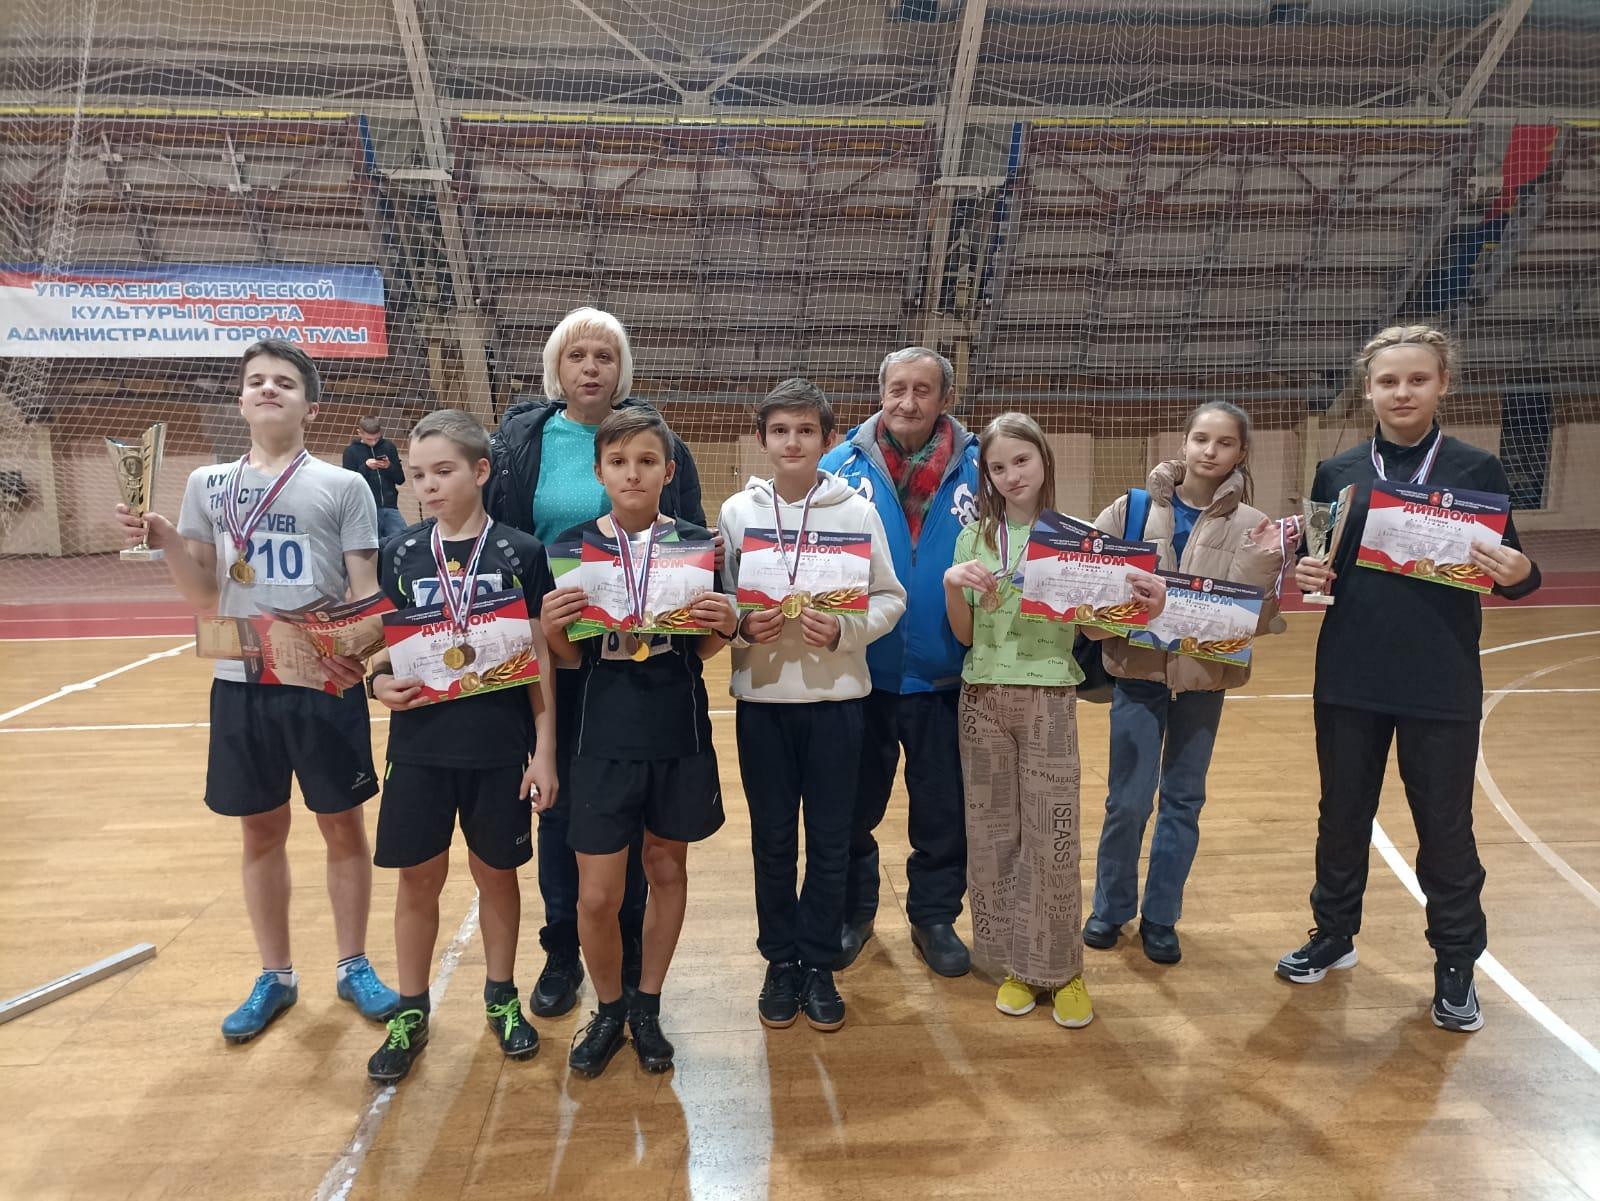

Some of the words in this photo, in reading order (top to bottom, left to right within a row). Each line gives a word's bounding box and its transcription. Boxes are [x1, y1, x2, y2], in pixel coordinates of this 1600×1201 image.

[34, 281, 182, 299] УПРАВЛЕНИЕ
[184, 280, 335, 299] ФИЗИЧЕСКОЙ
[71, 304, 193, 320] КУЛЬТУРЫ
[195, 304, 214, 320] И
[216, 304, 304, 321] СПОРТА
[6, 326, 210, 342] АДМИНИСТРАЦИИ
[214, 326, 303, 343] ГОРОДА
[304, 327, 367, 343] ТУЛЫ
[1403, 501, 1476, 524] ДИПЛОМ
[1058, 550, 1126, 566] ДИПЛОМ
[1167, 587, 1234, 607] ДИПЛОМ
[1054, 802, 1072, 863] ISEASS
